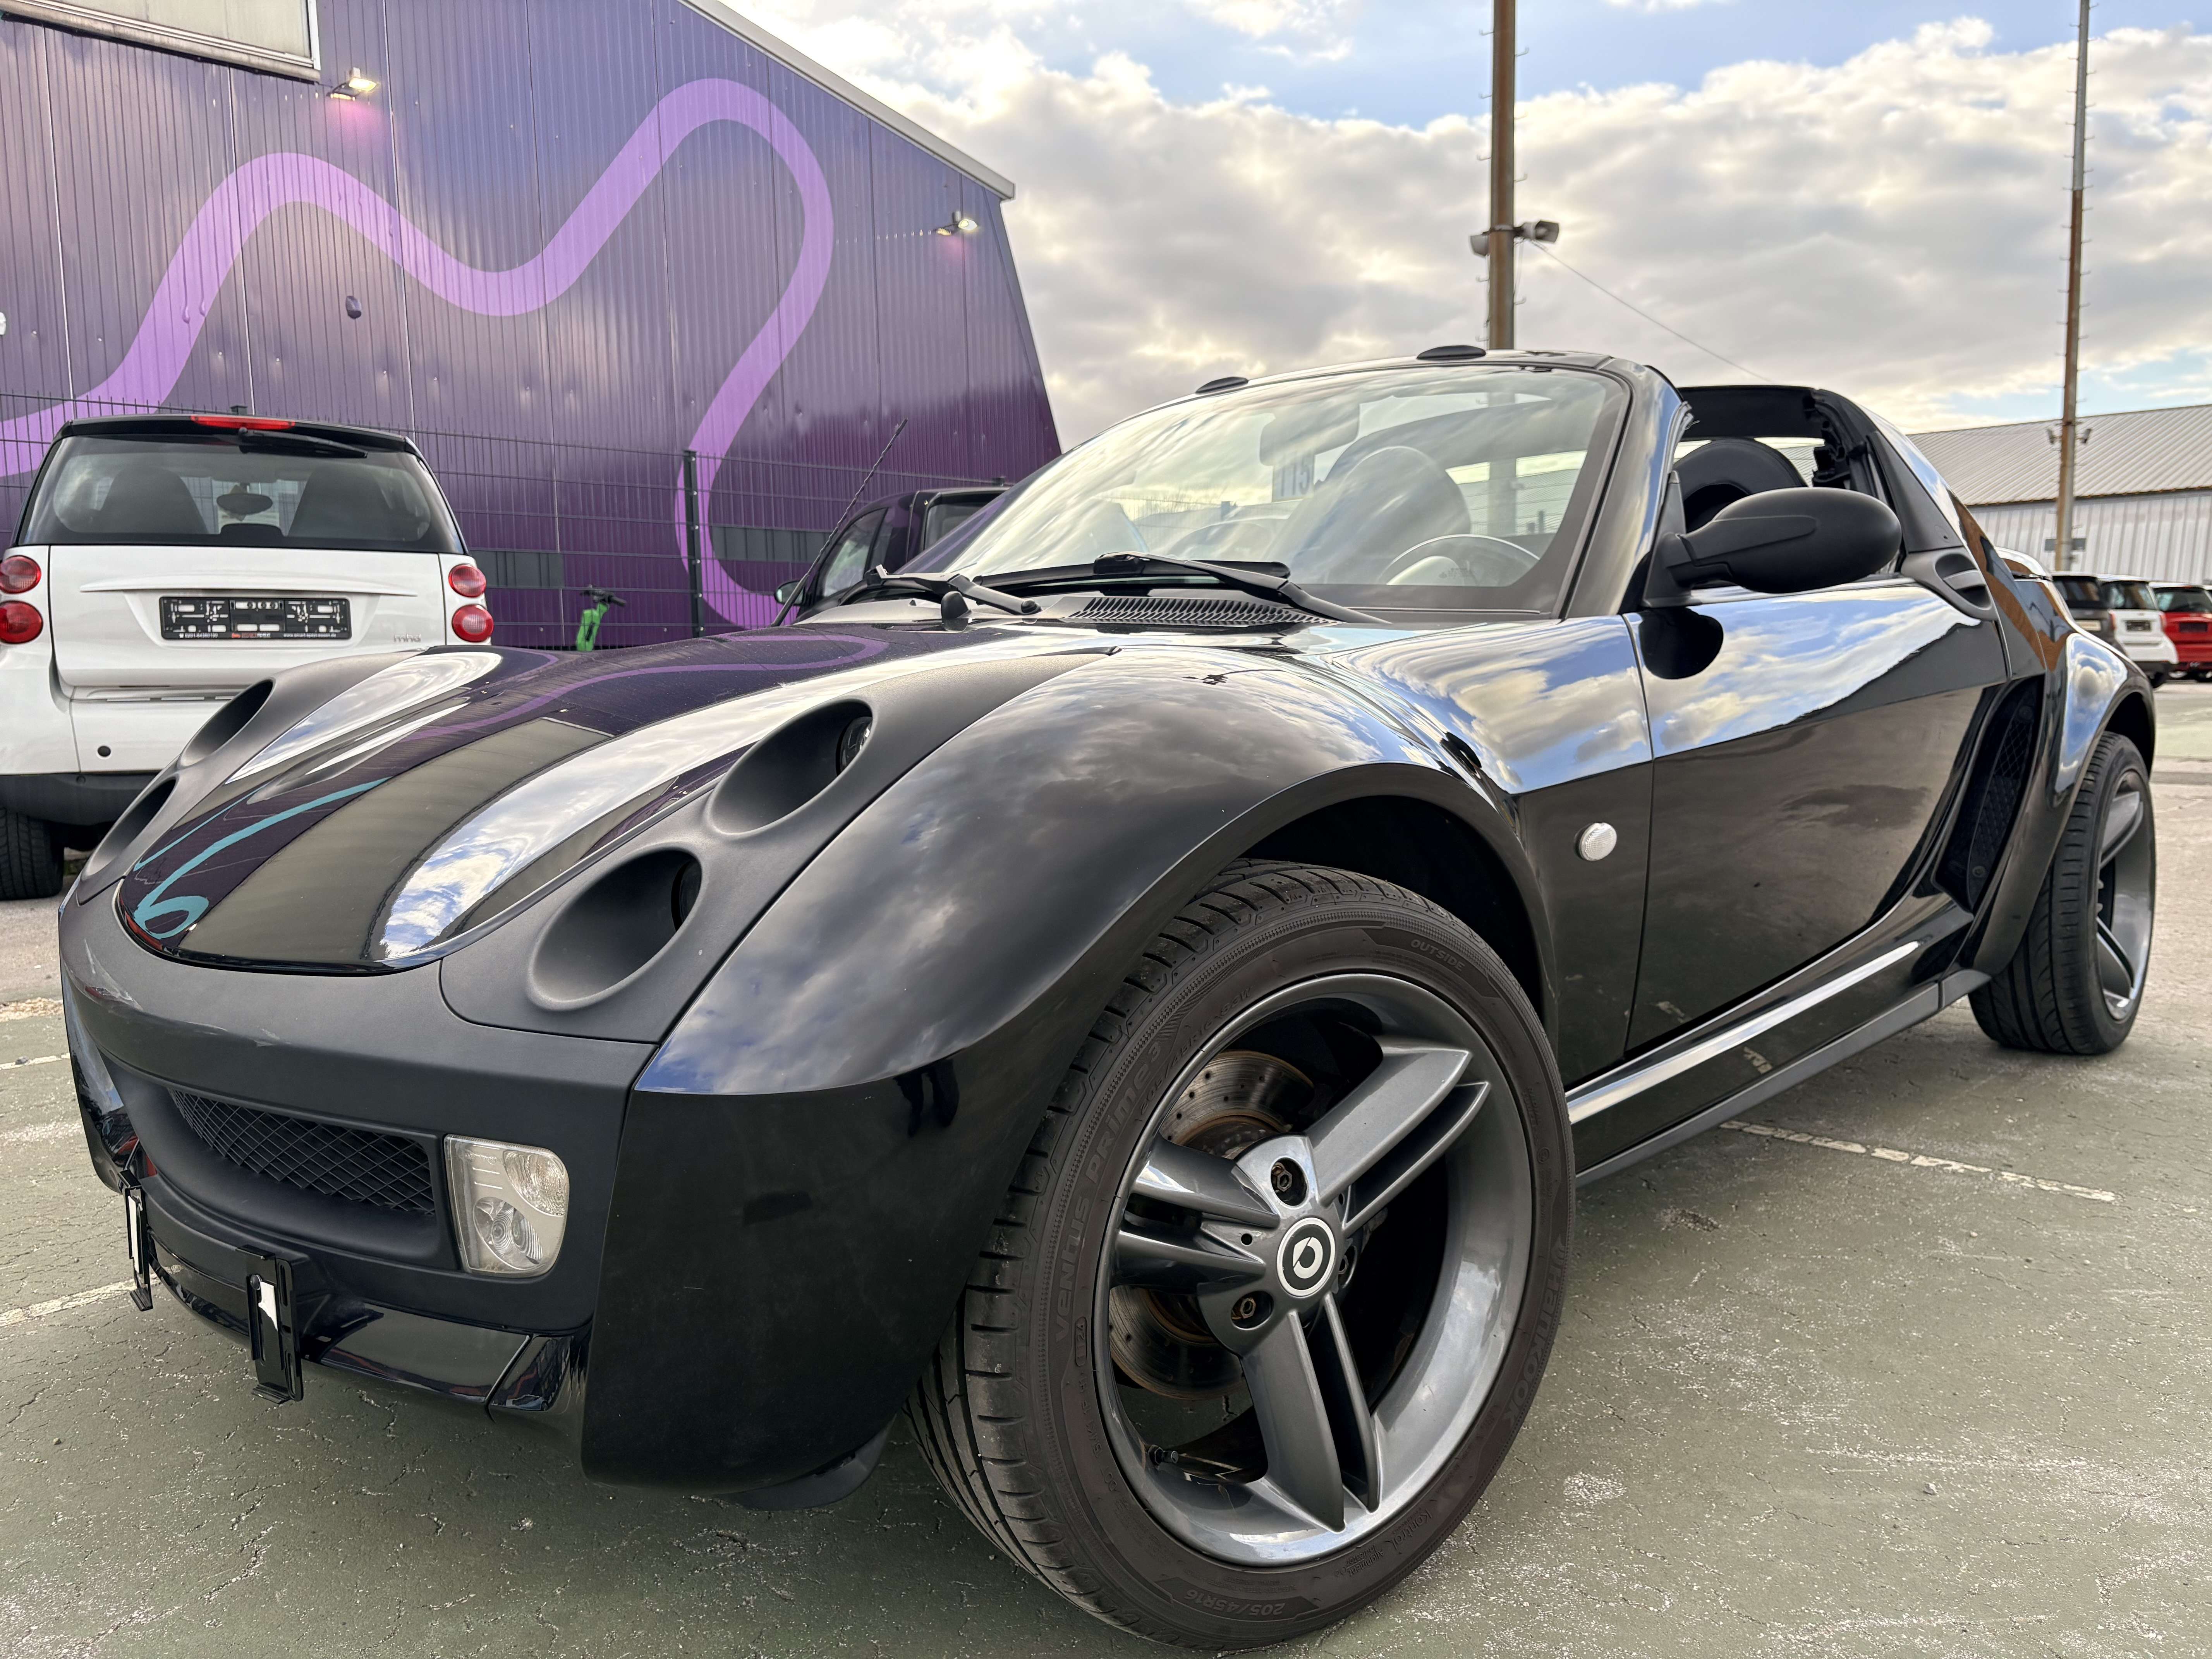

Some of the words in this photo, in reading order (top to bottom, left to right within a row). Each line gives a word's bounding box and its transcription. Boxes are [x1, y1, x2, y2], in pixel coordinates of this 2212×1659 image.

[393, 634, 421, 642] mhd
[1410, 939, 1466, 972] OUTSIDE
[1183, 1589, 1285, 1616] 205/45R16
